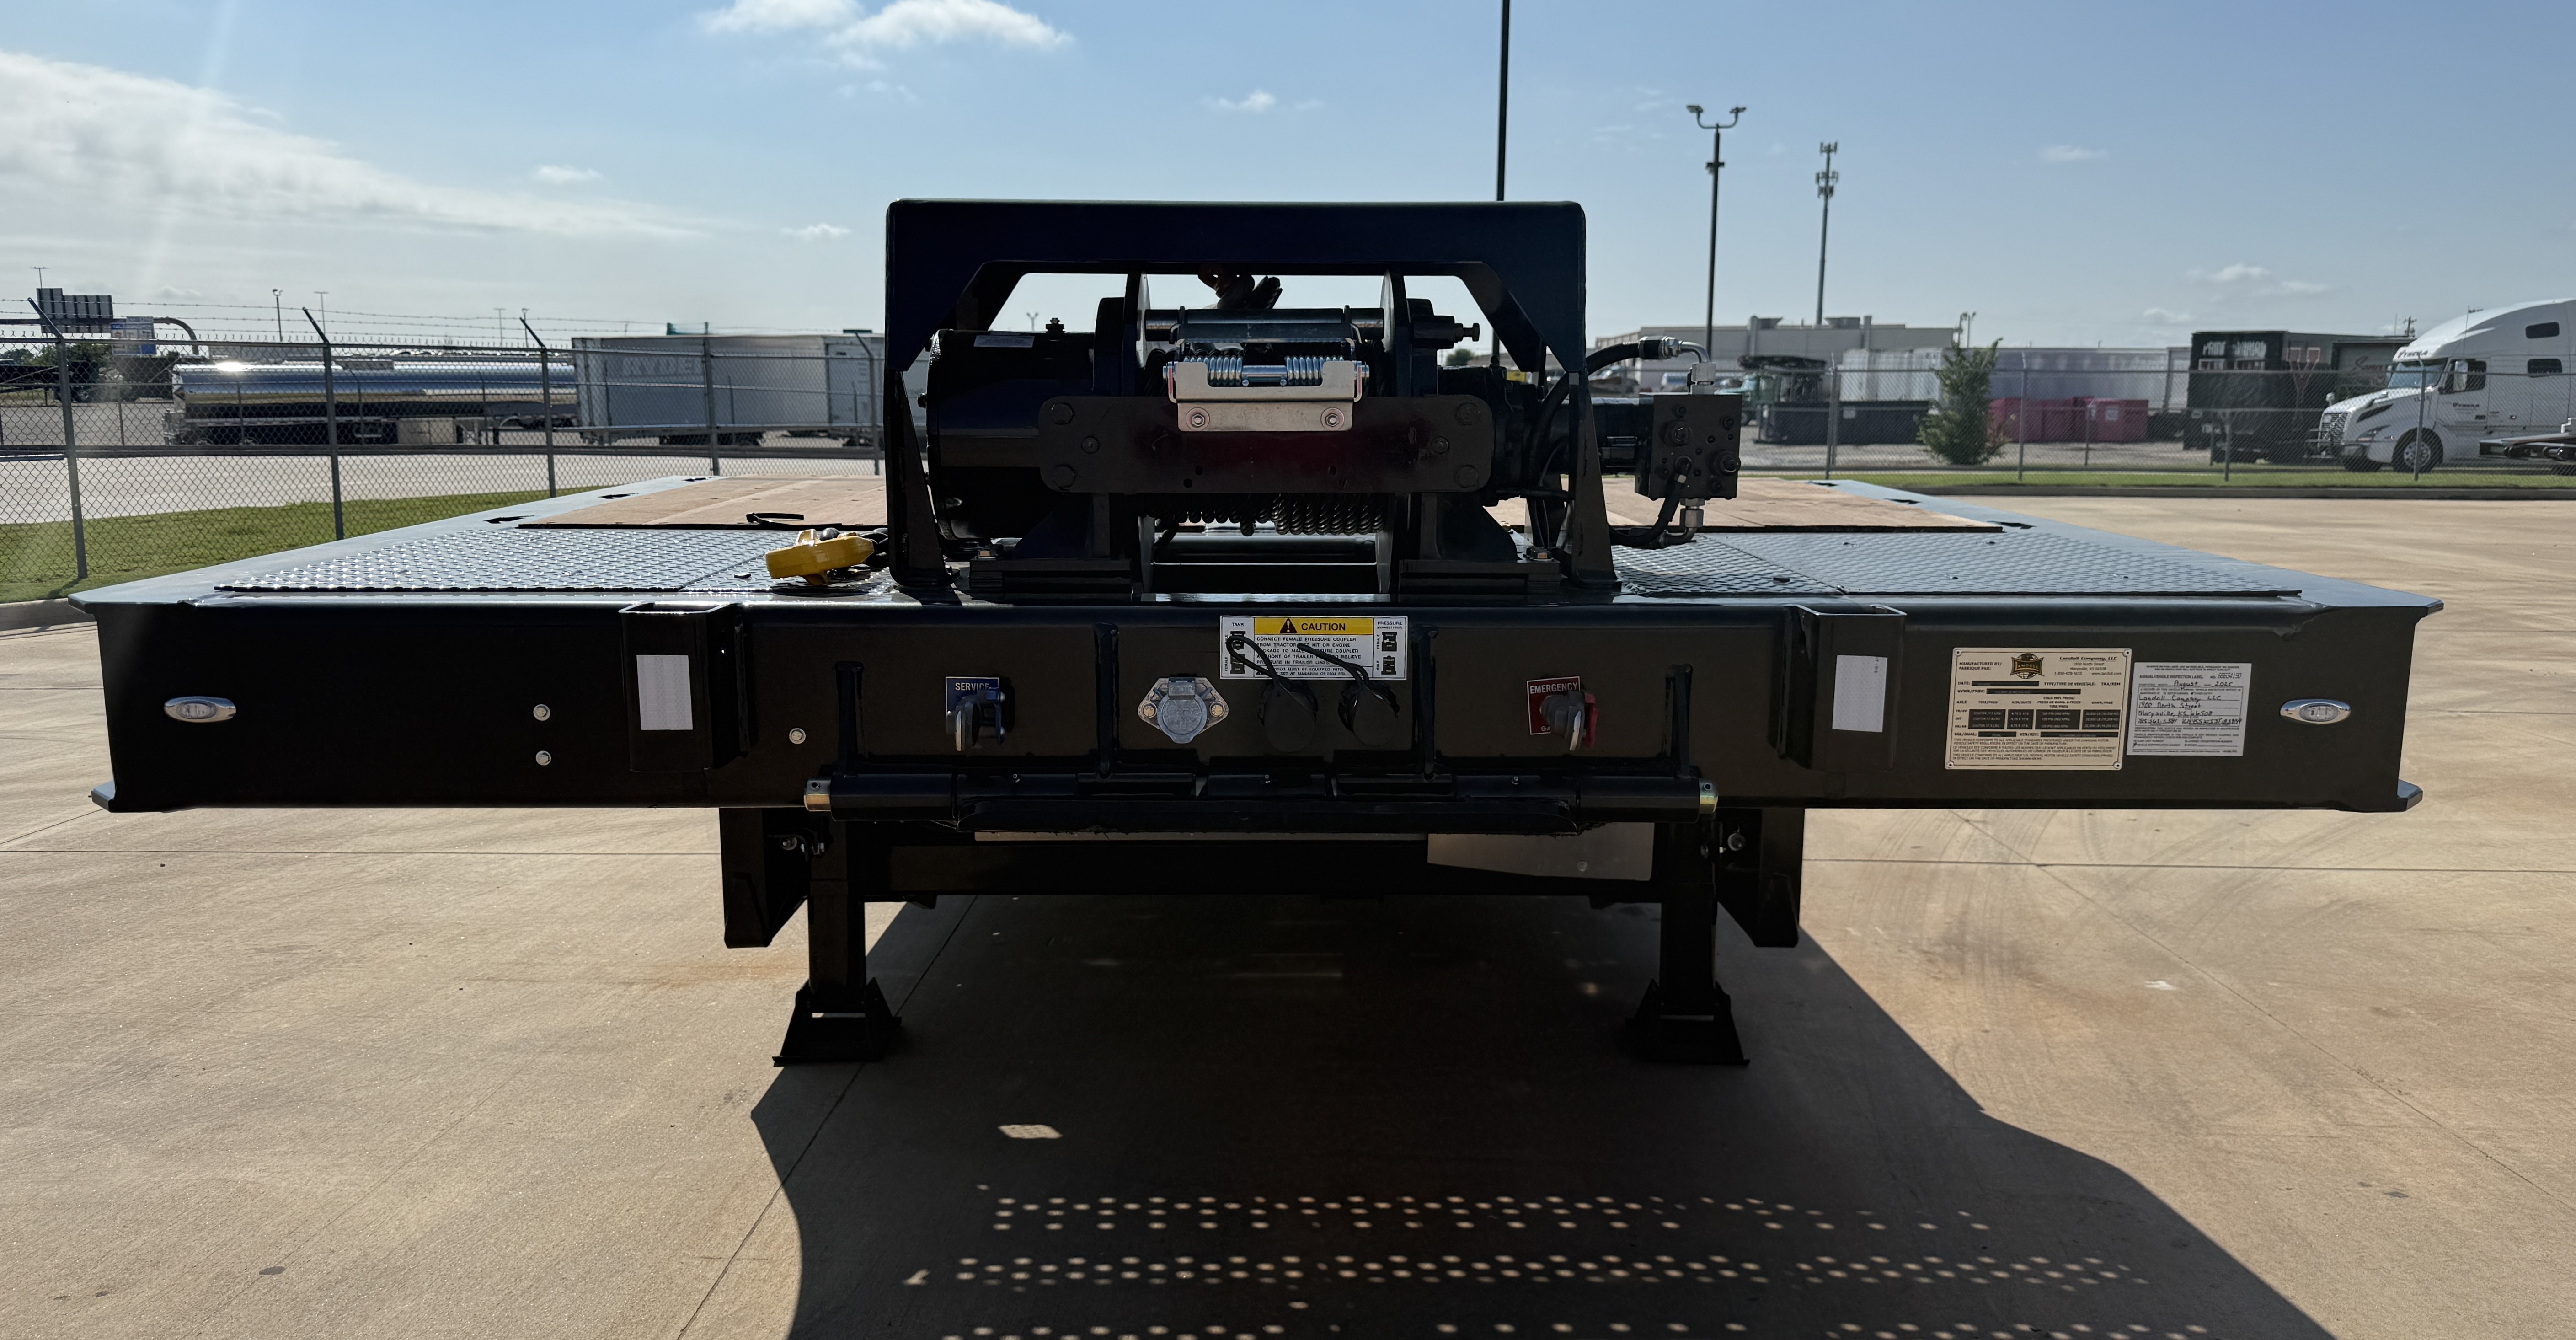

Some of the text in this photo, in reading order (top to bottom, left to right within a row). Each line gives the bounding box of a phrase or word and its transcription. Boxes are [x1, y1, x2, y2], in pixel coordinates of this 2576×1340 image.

[955, 682, 989, 691] SERVICE
[1529, 682, 1578, 694] EMERGENCY
[2174, 680, 2198, 691] August
